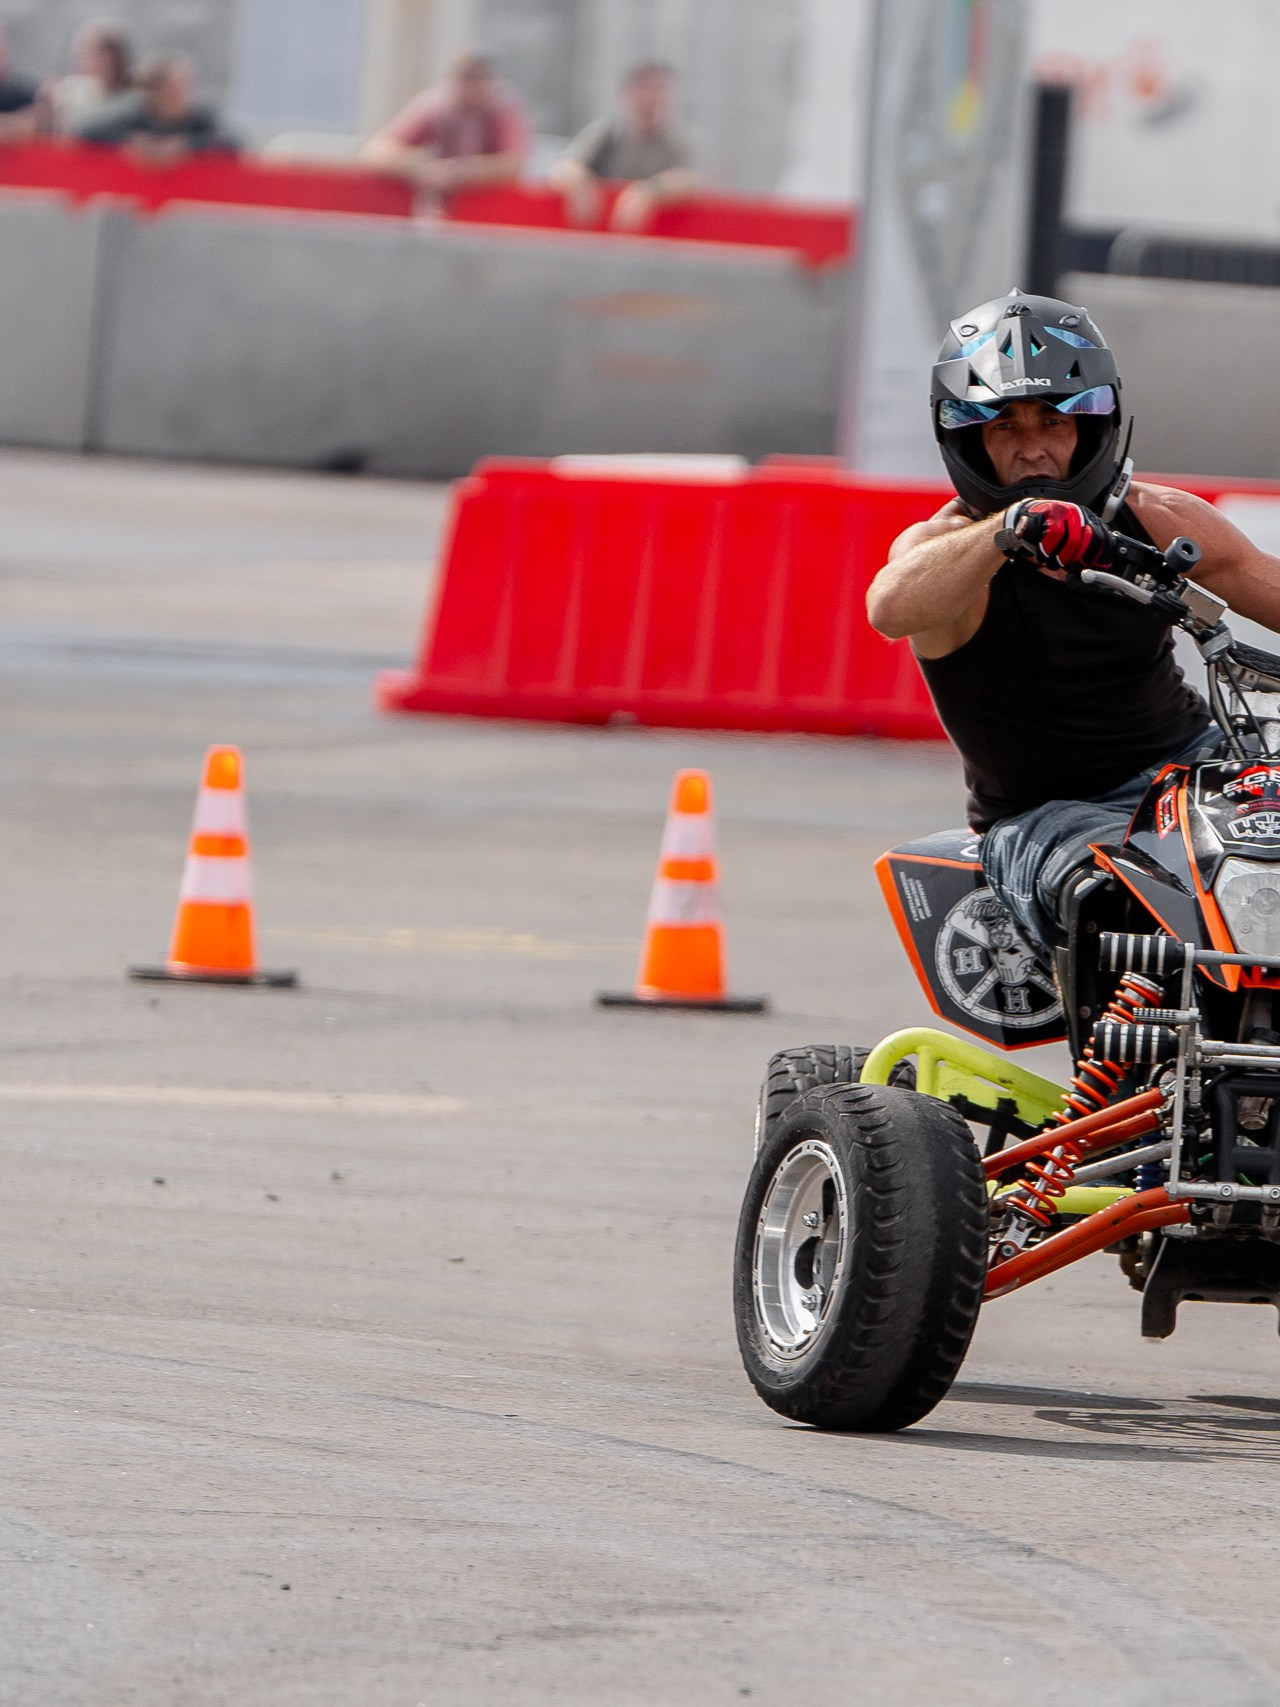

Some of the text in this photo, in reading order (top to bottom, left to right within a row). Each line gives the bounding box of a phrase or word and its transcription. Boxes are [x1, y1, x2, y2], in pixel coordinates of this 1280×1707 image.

[1001, 378, 1051, 391] ATAKI
[953, 945, 984, 975] H
[1001, 986, 1032, 1013] H
